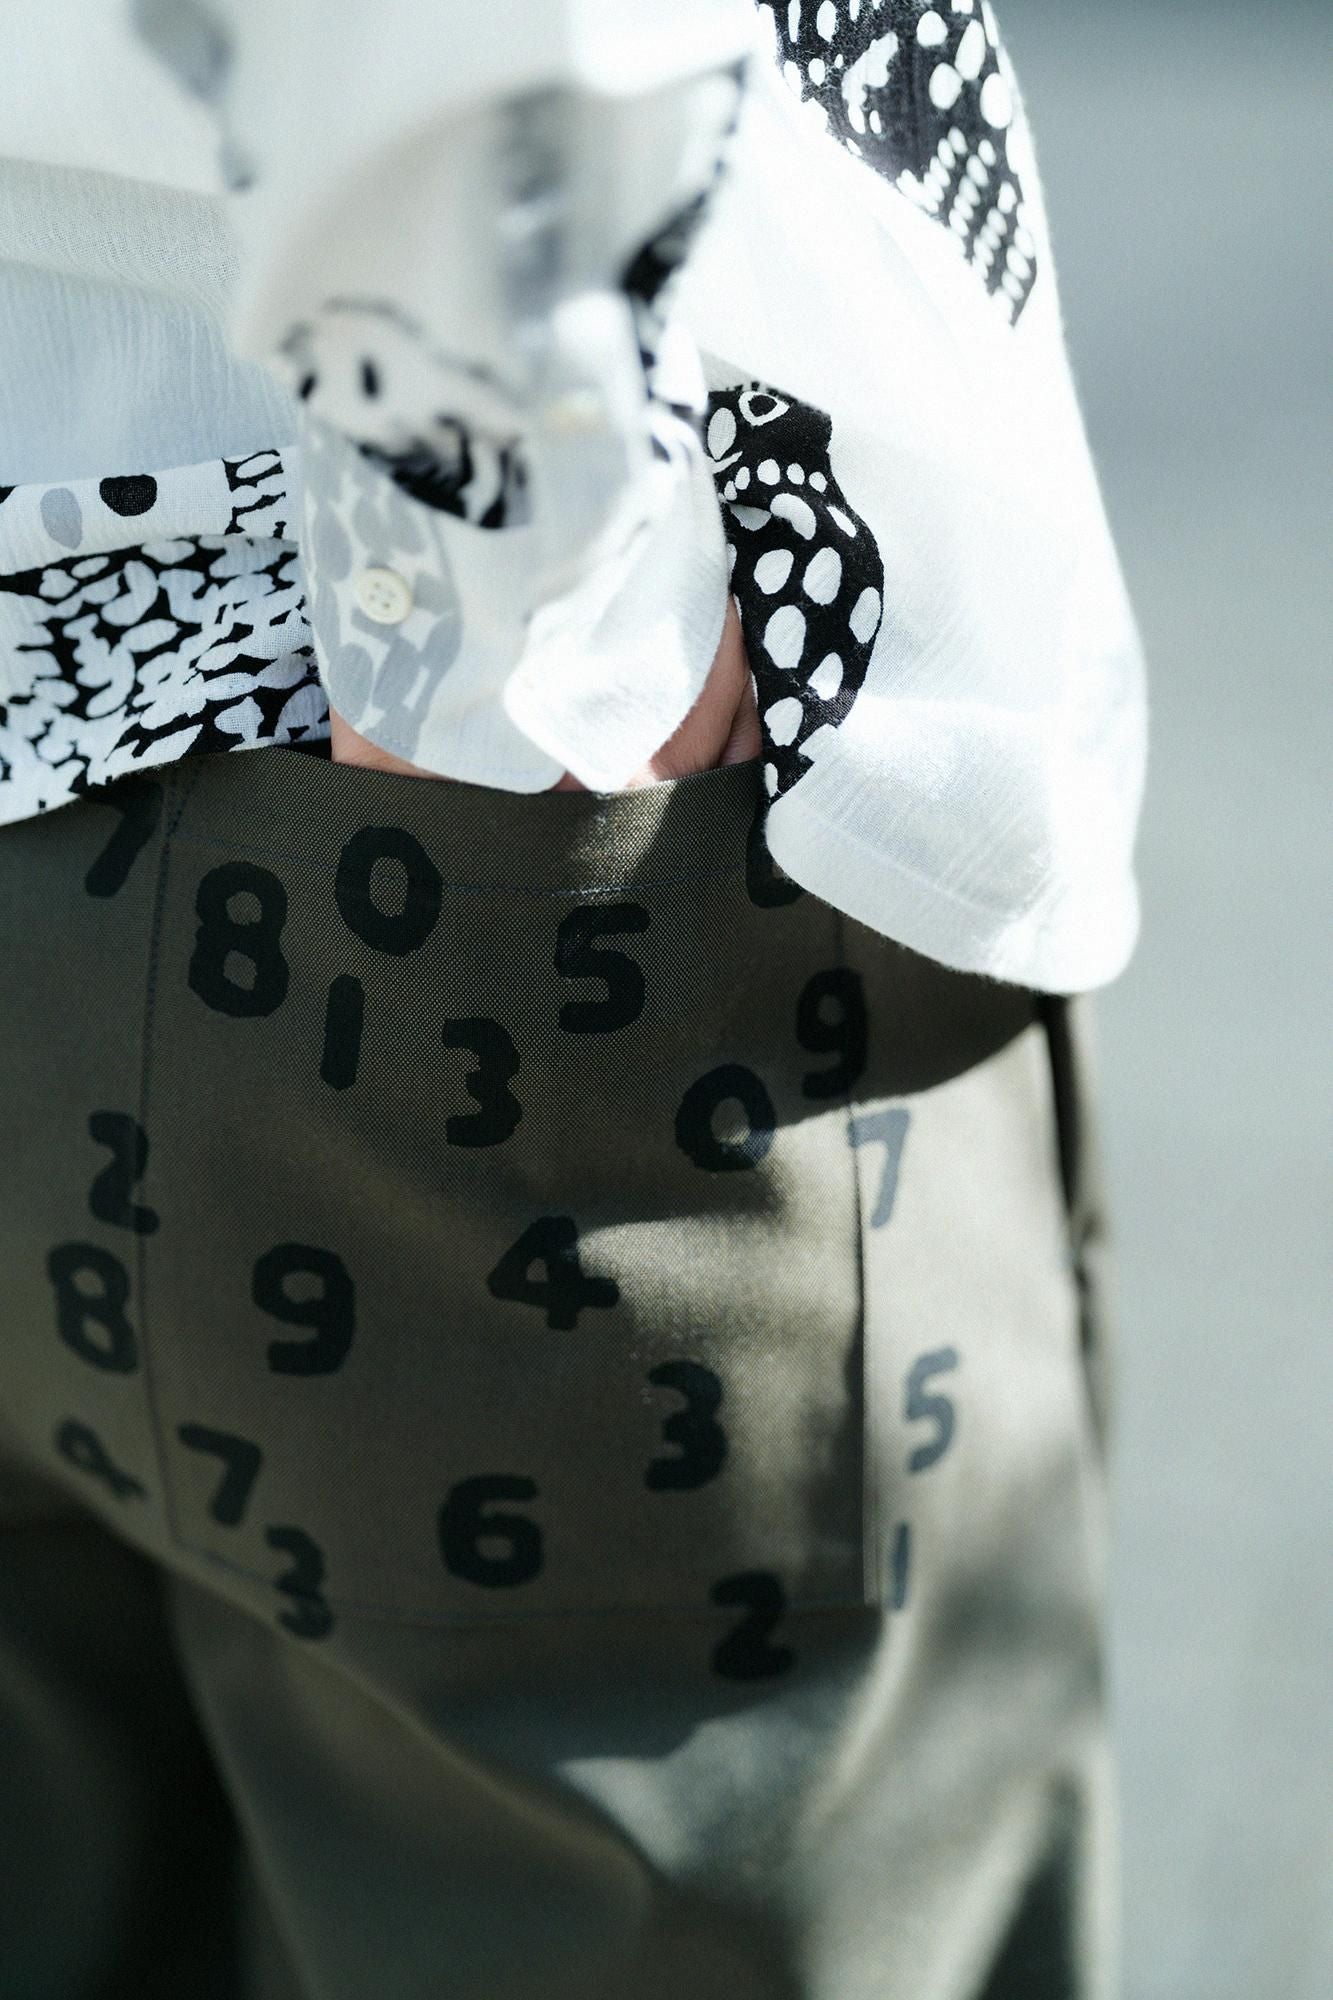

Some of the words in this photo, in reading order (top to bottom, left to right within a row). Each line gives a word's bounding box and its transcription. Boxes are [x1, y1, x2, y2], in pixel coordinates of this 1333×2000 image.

[80, 778, 164, 898] 7
[335, 825, 443, 956] 0
[188, 861, 290, 1019] 8
[554, 902, 651, 1034] 5
[442, 1016, 523, 1148] 3
[796, 966, 868, 1101] 9
[88, 1110, 160, 1236] 2
[675, 1063, 777, 1172] 0
[848, 1107, 911, 1230] 7
[48, 1242, 138, 1374] 8
[252, 1243, 356, 1376] 9
[487, 1215, 620, 1331] 4
[177, 1423, 263, 1527] 7
[644, 1360, 730, 1491] 3
[904, 1346, 960, 1476] 5
[266, 1525, 335, 1640] 3
[438, 1473, 544, 1588] 6
[710, 1570, 796, 1681] 2
